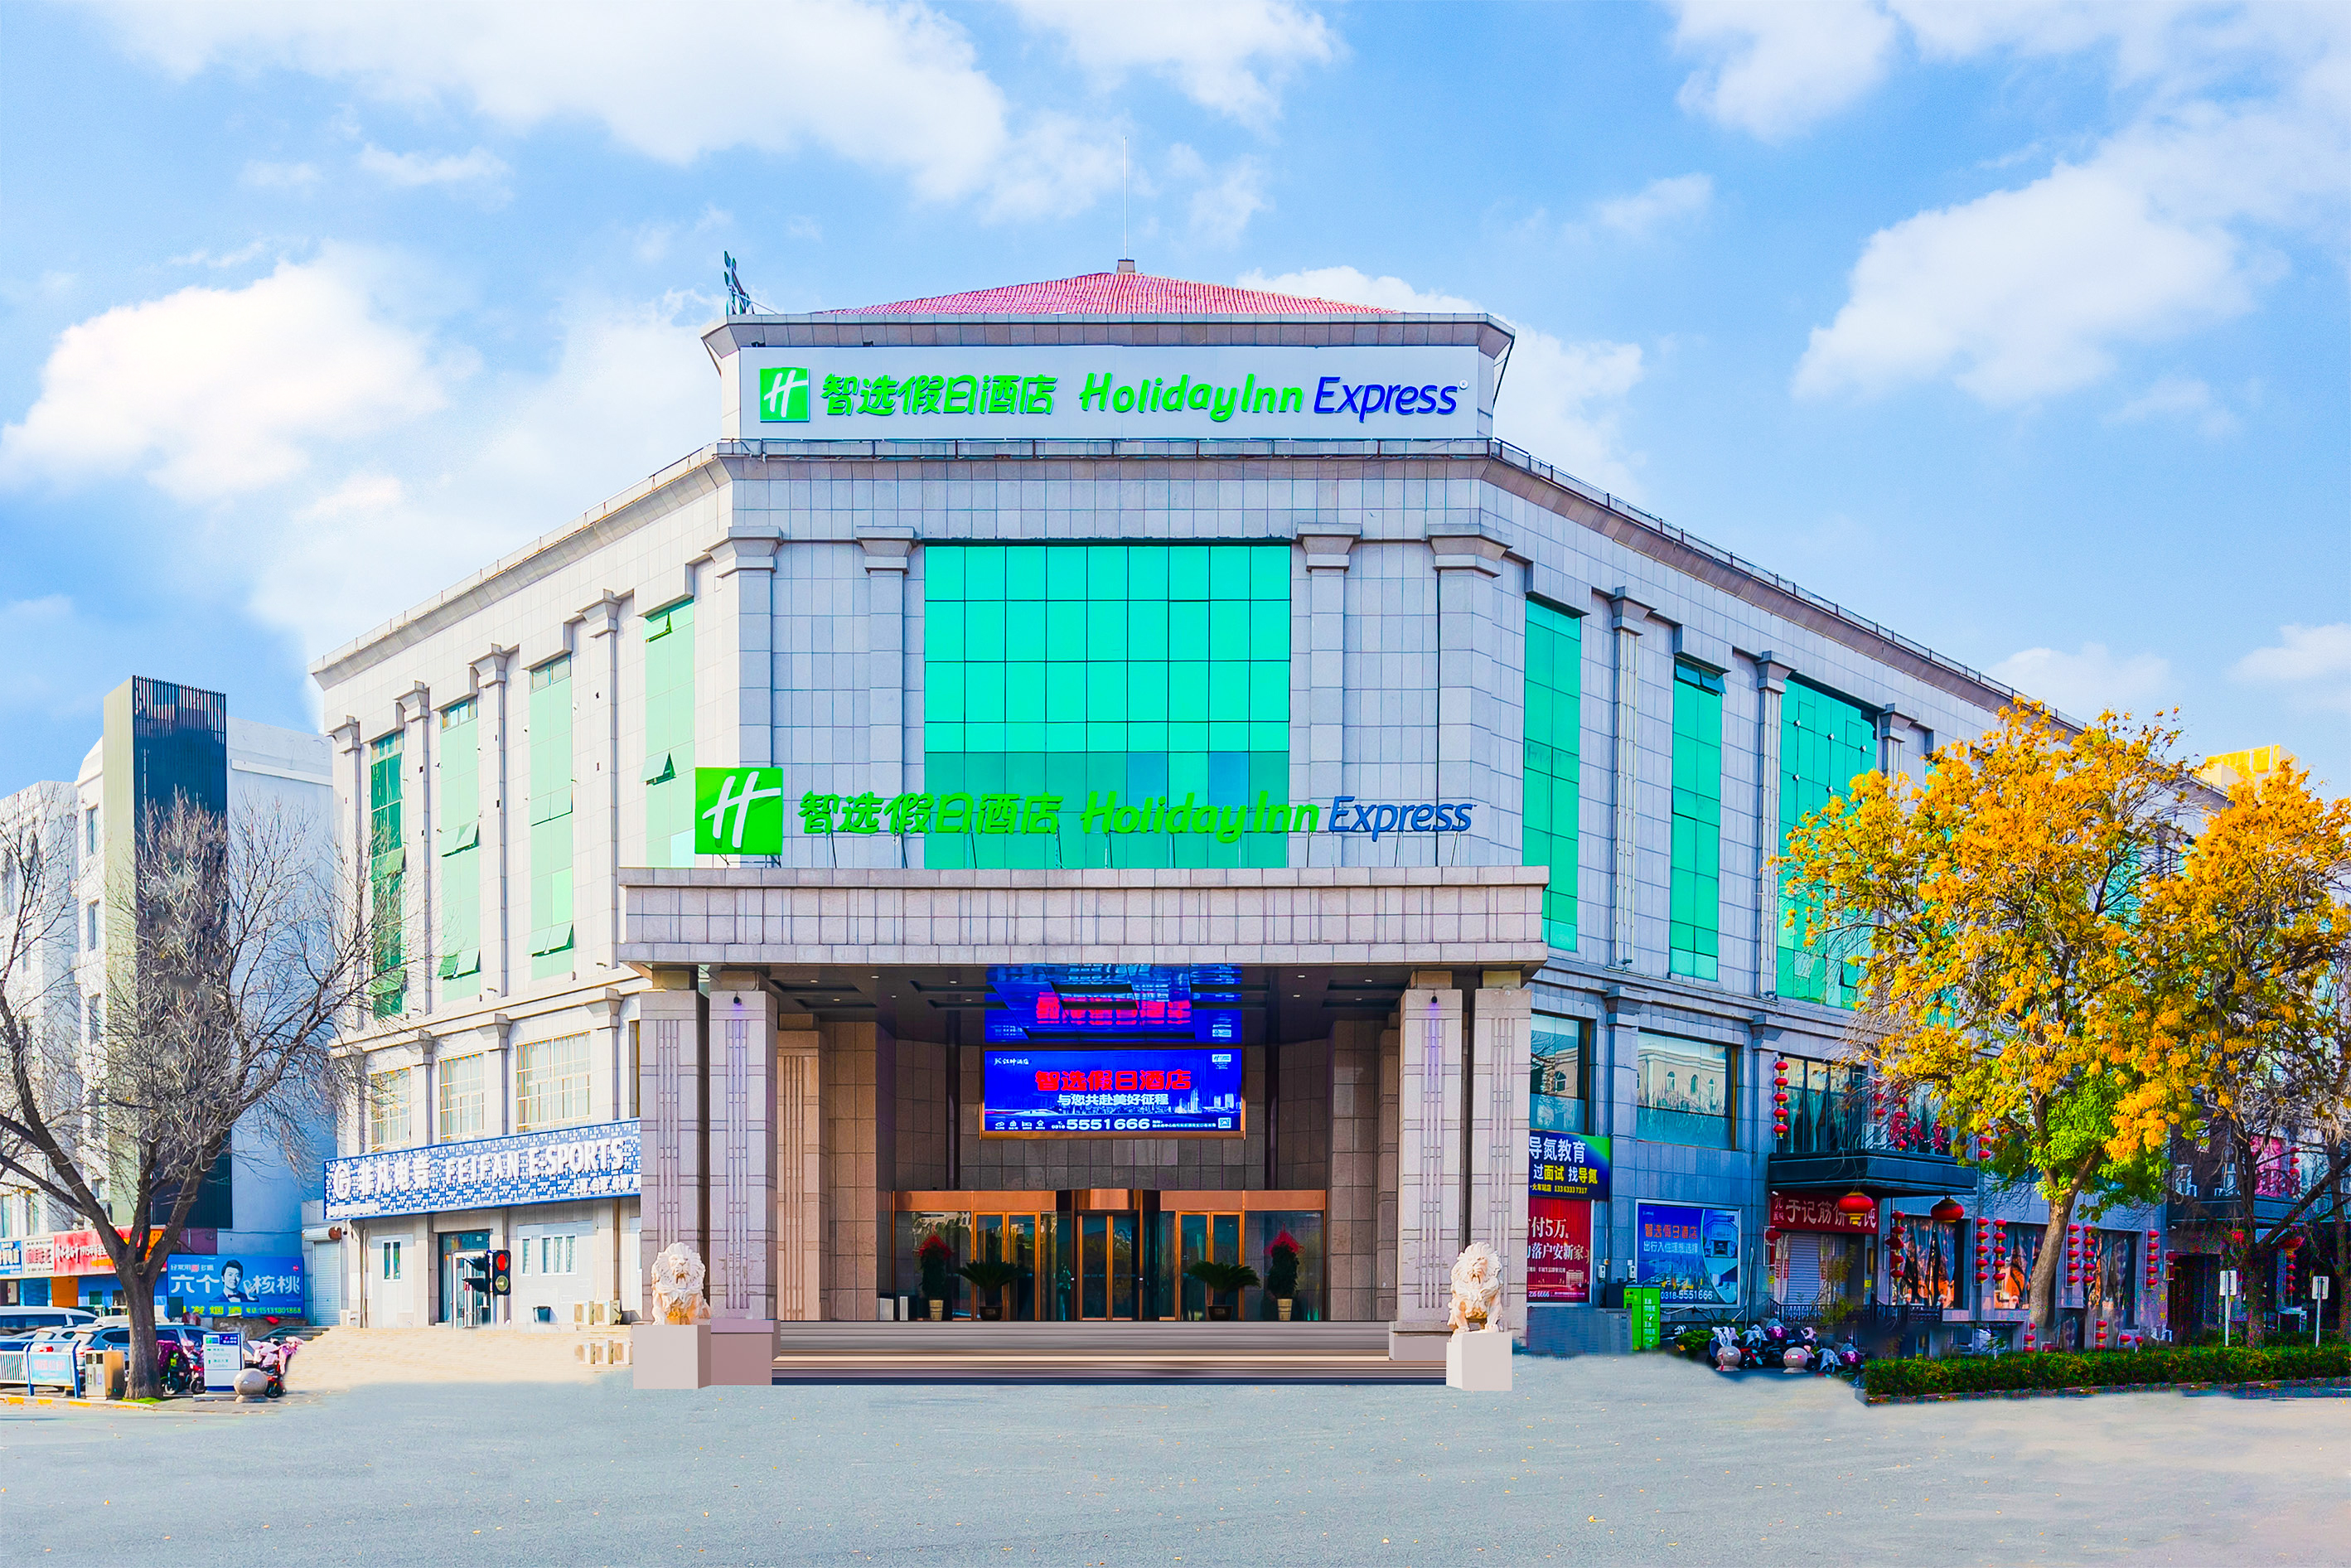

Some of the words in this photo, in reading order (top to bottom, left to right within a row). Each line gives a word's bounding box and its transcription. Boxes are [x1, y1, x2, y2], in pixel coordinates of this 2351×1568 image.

[820, 373, 1057, 415] 智选假日酒店
[1313, 376, 1458, 422] Express
[797, 790, 1066, 835] 智选假日酒店
[1328, 795, 1473, 842] Express
[1035, 1069, 1192, 1091] 智选假日酒店
[1057, 1093, 1168, 1106] 与您共赴美好征程
[1067, 1118, 1150, 1130] 5551666
[1529, 1136, 1586, 1164] 导氮教育
[358, 1156, 431, 1195] 非凡电竞
[1533, 1164, 1564, 1181] 过面试
[1568, 1166, 1598, 1184] 找导氮
[1528, 1217, 1569, 1239] 付5万
[1644, 1223, 1698, 1240] 智选假日酒店
[171, 1275, 220, 1294] 六个
[252, 1275, 300, 1295] 核桃
